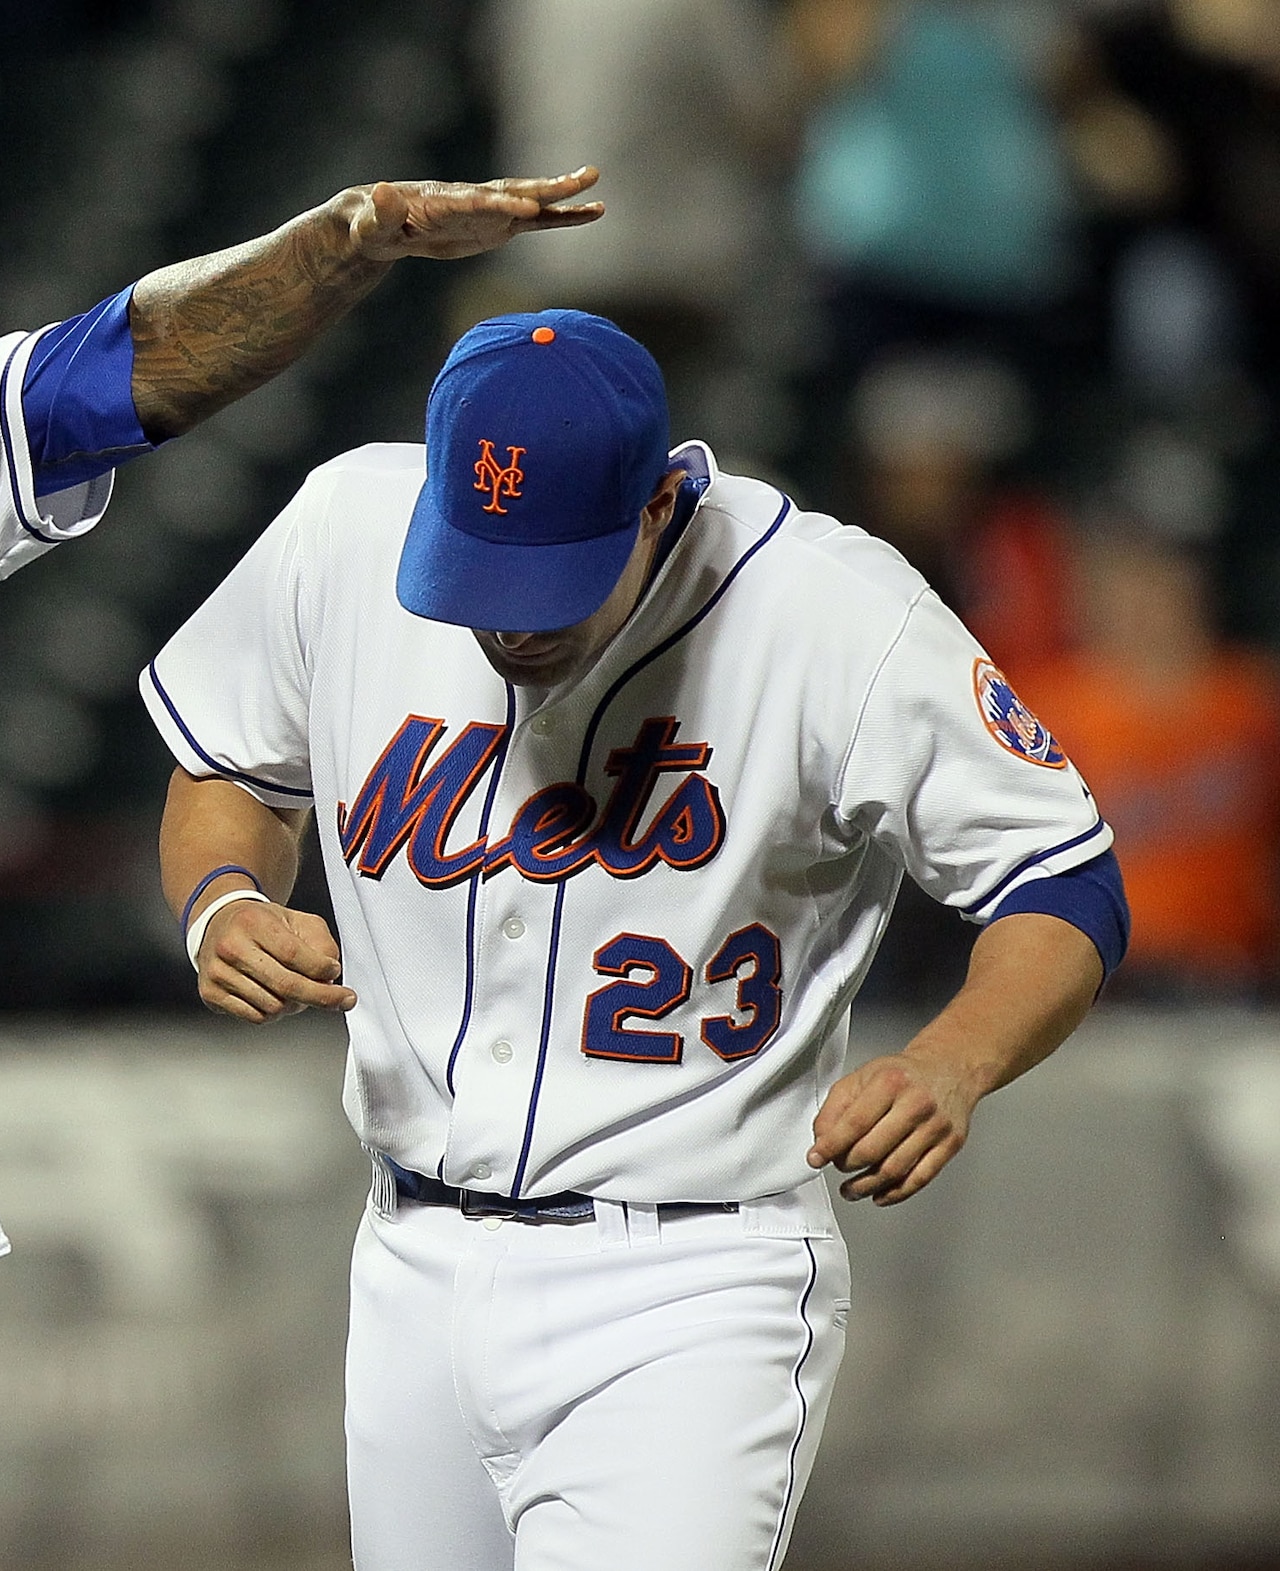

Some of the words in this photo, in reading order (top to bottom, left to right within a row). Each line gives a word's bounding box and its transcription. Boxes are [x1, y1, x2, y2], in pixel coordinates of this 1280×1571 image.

[474, 439, 527, 515] NY
[338, 713, 726, 890] Mets
[581, 922, 782, 1064] 23
